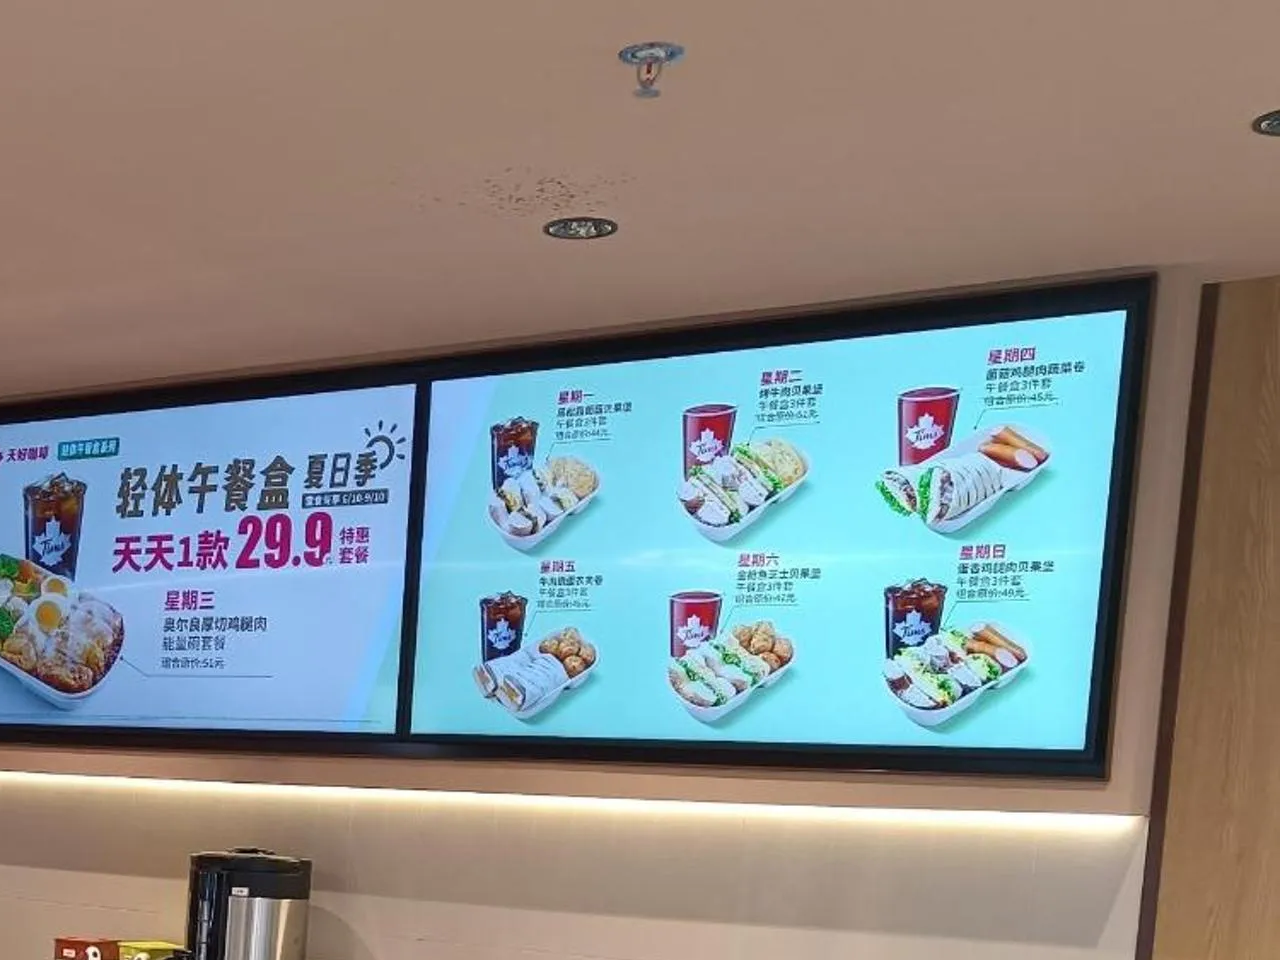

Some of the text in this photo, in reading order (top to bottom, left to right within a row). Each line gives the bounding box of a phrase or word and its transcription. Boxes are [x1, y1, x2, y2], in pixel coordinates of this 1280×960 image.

[987, 347, 1036, 364] 星期四
[761, 369, 803, 386] 星期二
[557, 389, 595, 405] 星期一
[6, 445, 49, 462] 天好咖啡
[303, 451, 379, 489] 夏日季
[115, 455, 296, 519] 轻体午餐盒
[112, 511, 333, 574] 天天1款 29.9
[339, 527, 370, 544] 特惠
[339, 546, 369, 564] 套餐
[738, 552, 779, 567] 星期六
[959, 544, 1006, 560] 星期日
[540, 560, 576, 574] 星期五
[164, 589, 215, 611] 星期三
[163, 616, 268, 632] 奥尔良厚切鸡腿肉
